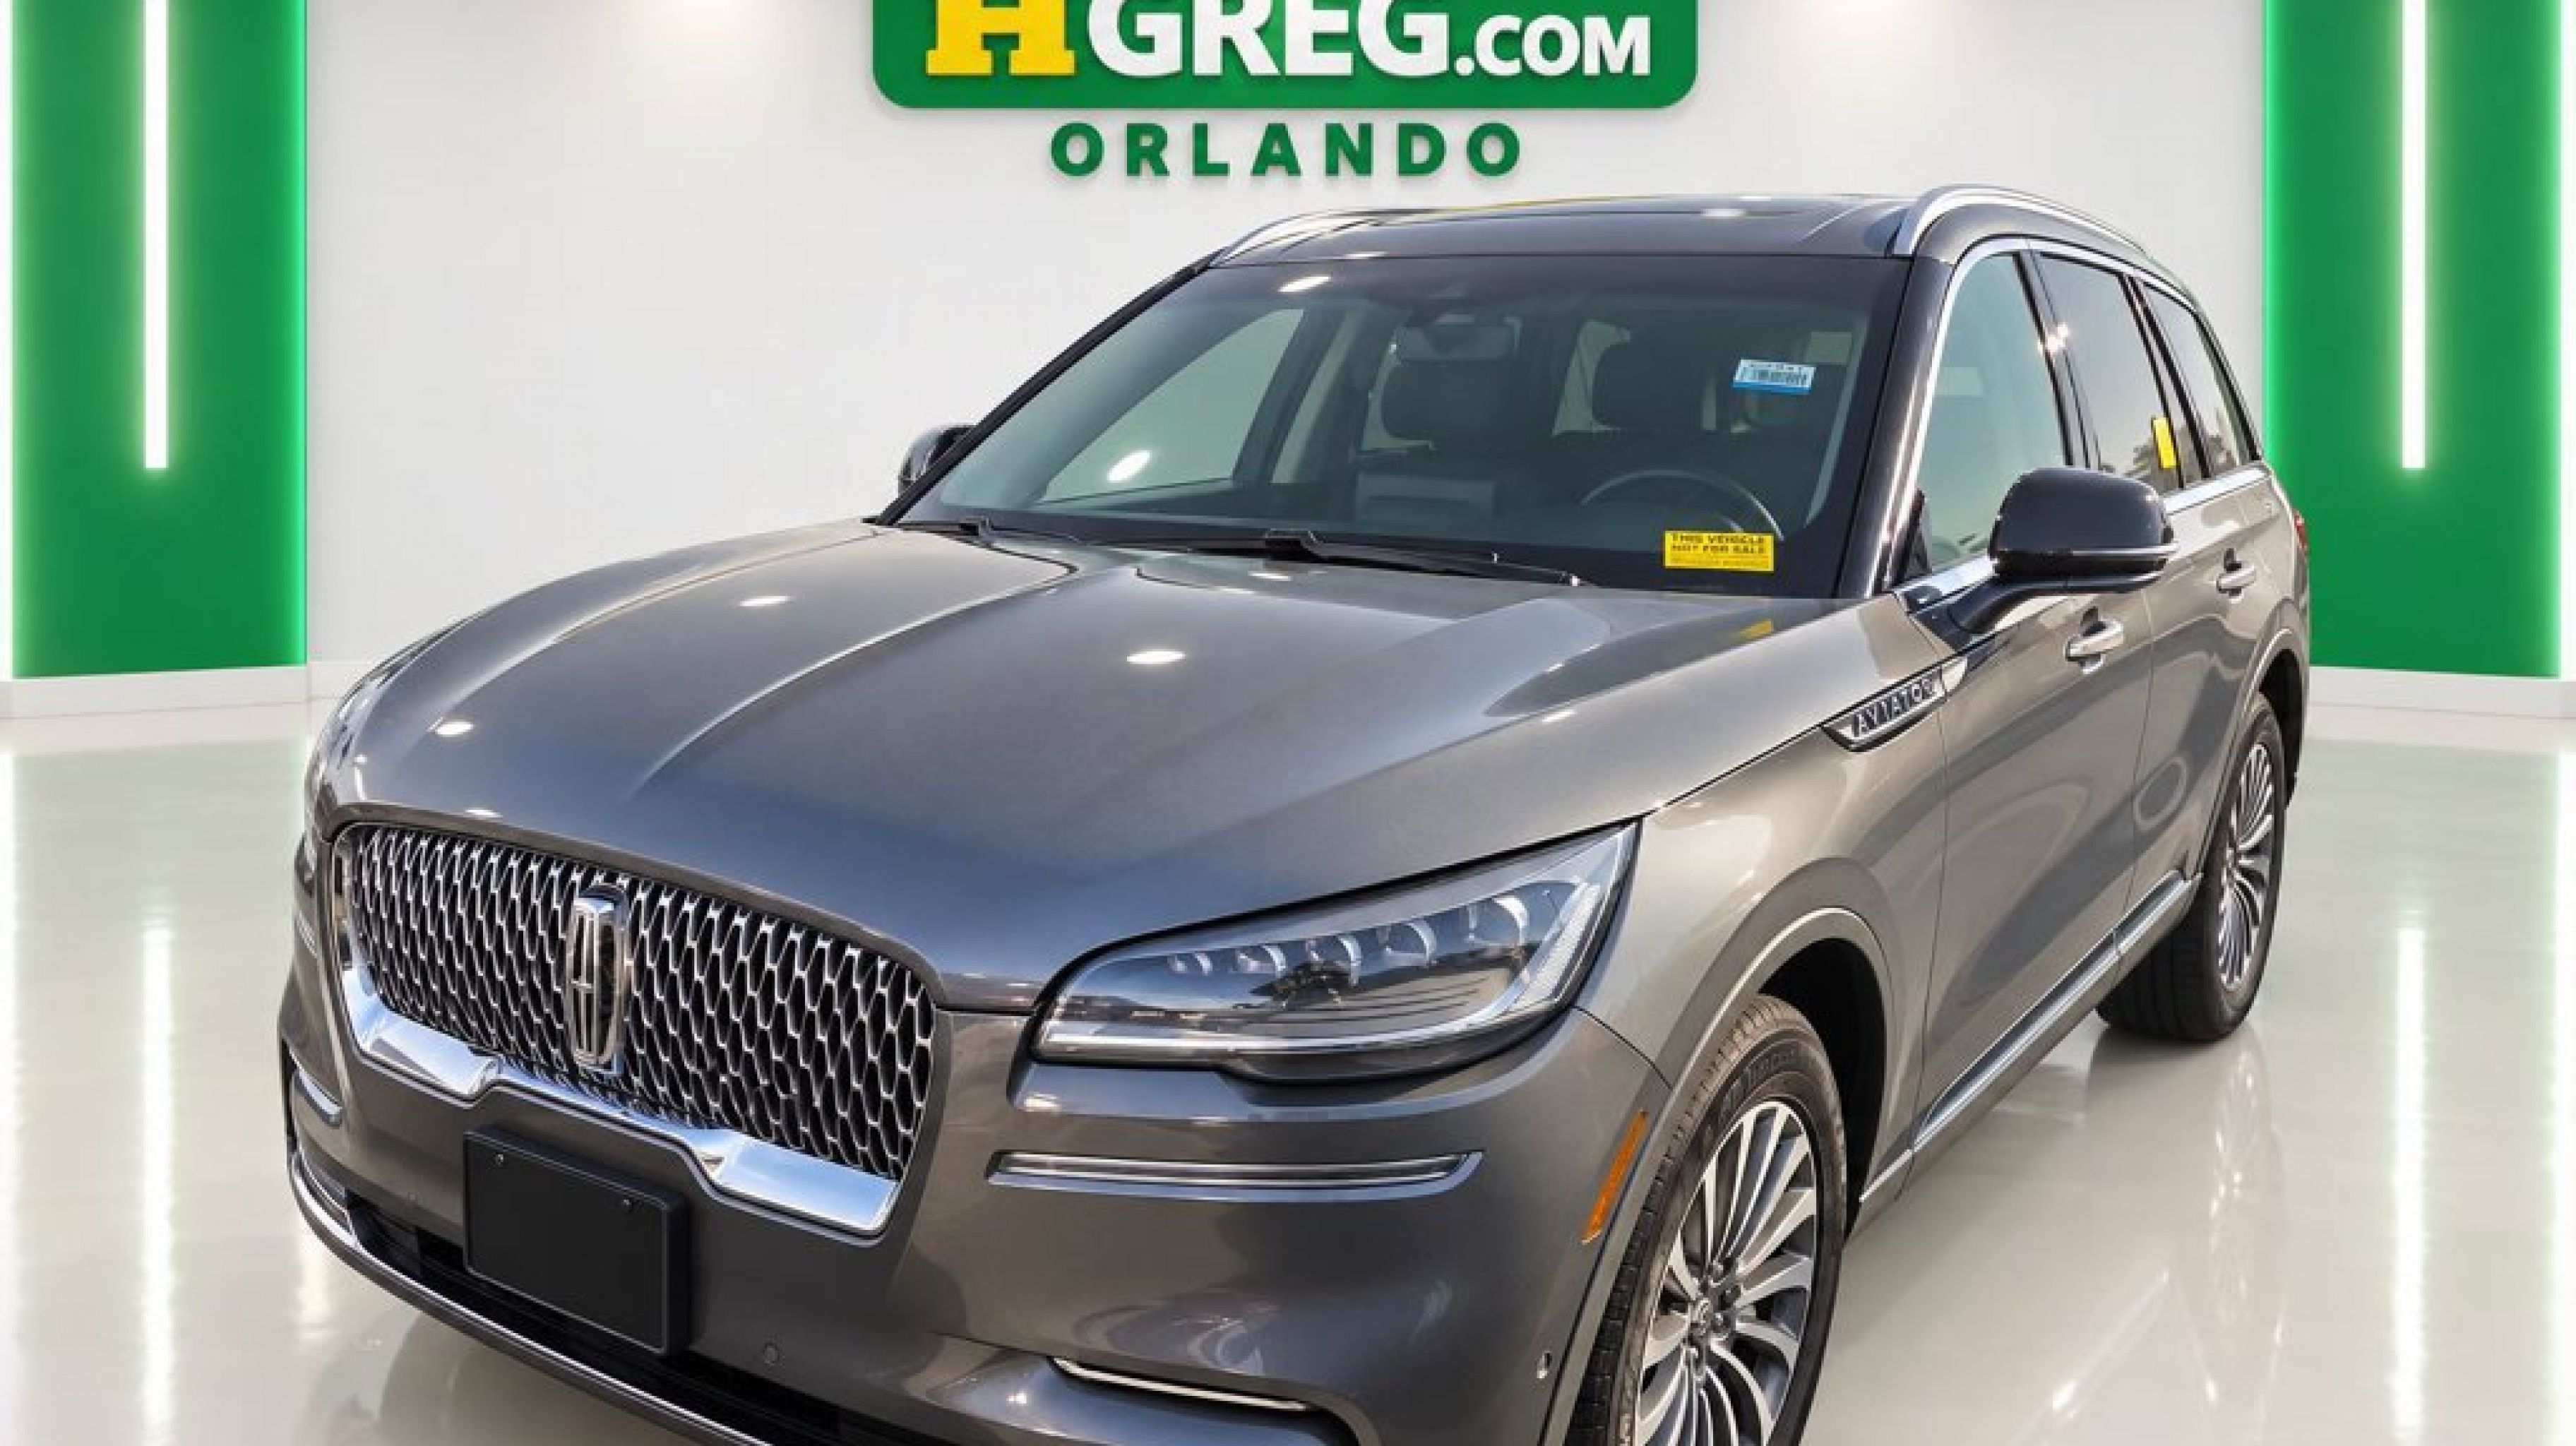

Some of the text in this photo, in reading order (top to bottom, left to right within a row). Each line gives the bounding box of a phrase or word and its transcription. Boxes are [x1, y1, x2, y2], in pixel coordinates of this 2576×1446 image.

[1050, 123, 1520, 177] ORLANDO
[1672, 534, 1765, 544] THIS VEHICLE
[1858, 679, 1934, 735] AVIATOR
